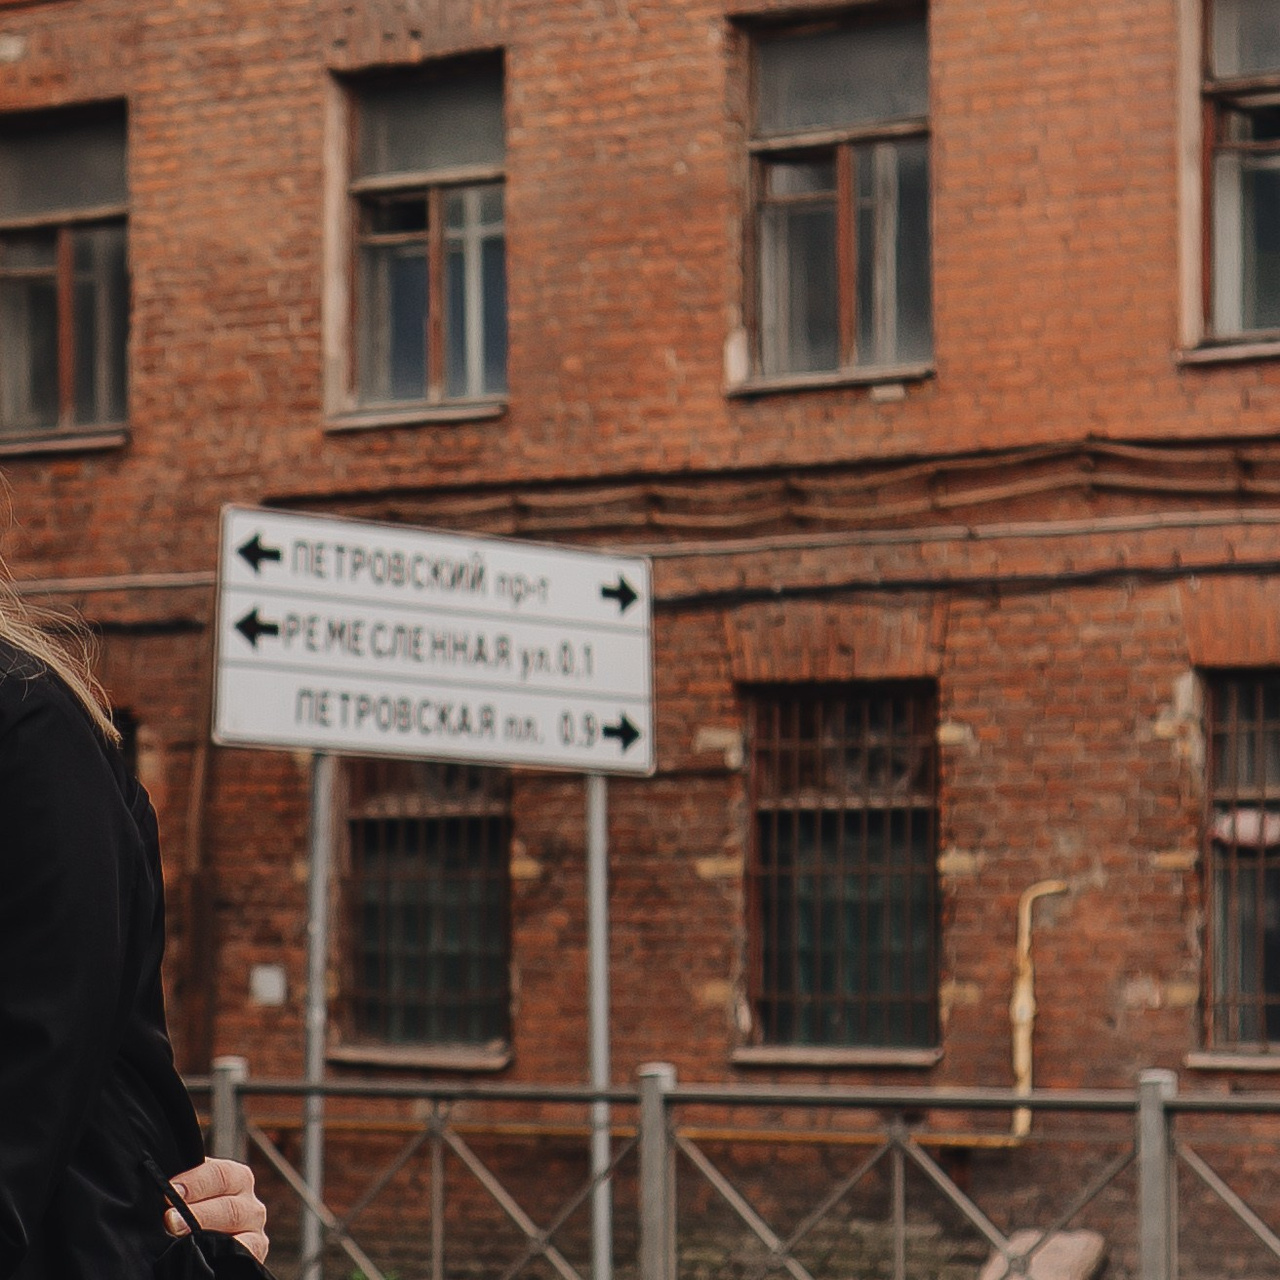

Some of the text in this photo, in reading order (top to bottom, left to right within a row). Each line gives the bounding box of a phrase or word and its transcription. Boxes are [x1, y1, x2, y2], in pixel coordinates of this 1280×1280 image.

[292, 538, 550, 608] ПЕТРОВСКИЙ пр-т
[282, 612, 513, 668] РЕМЕСЛЕННАЯ
[294, 687, 497, 739] ПЕТРОВСКАЯ
